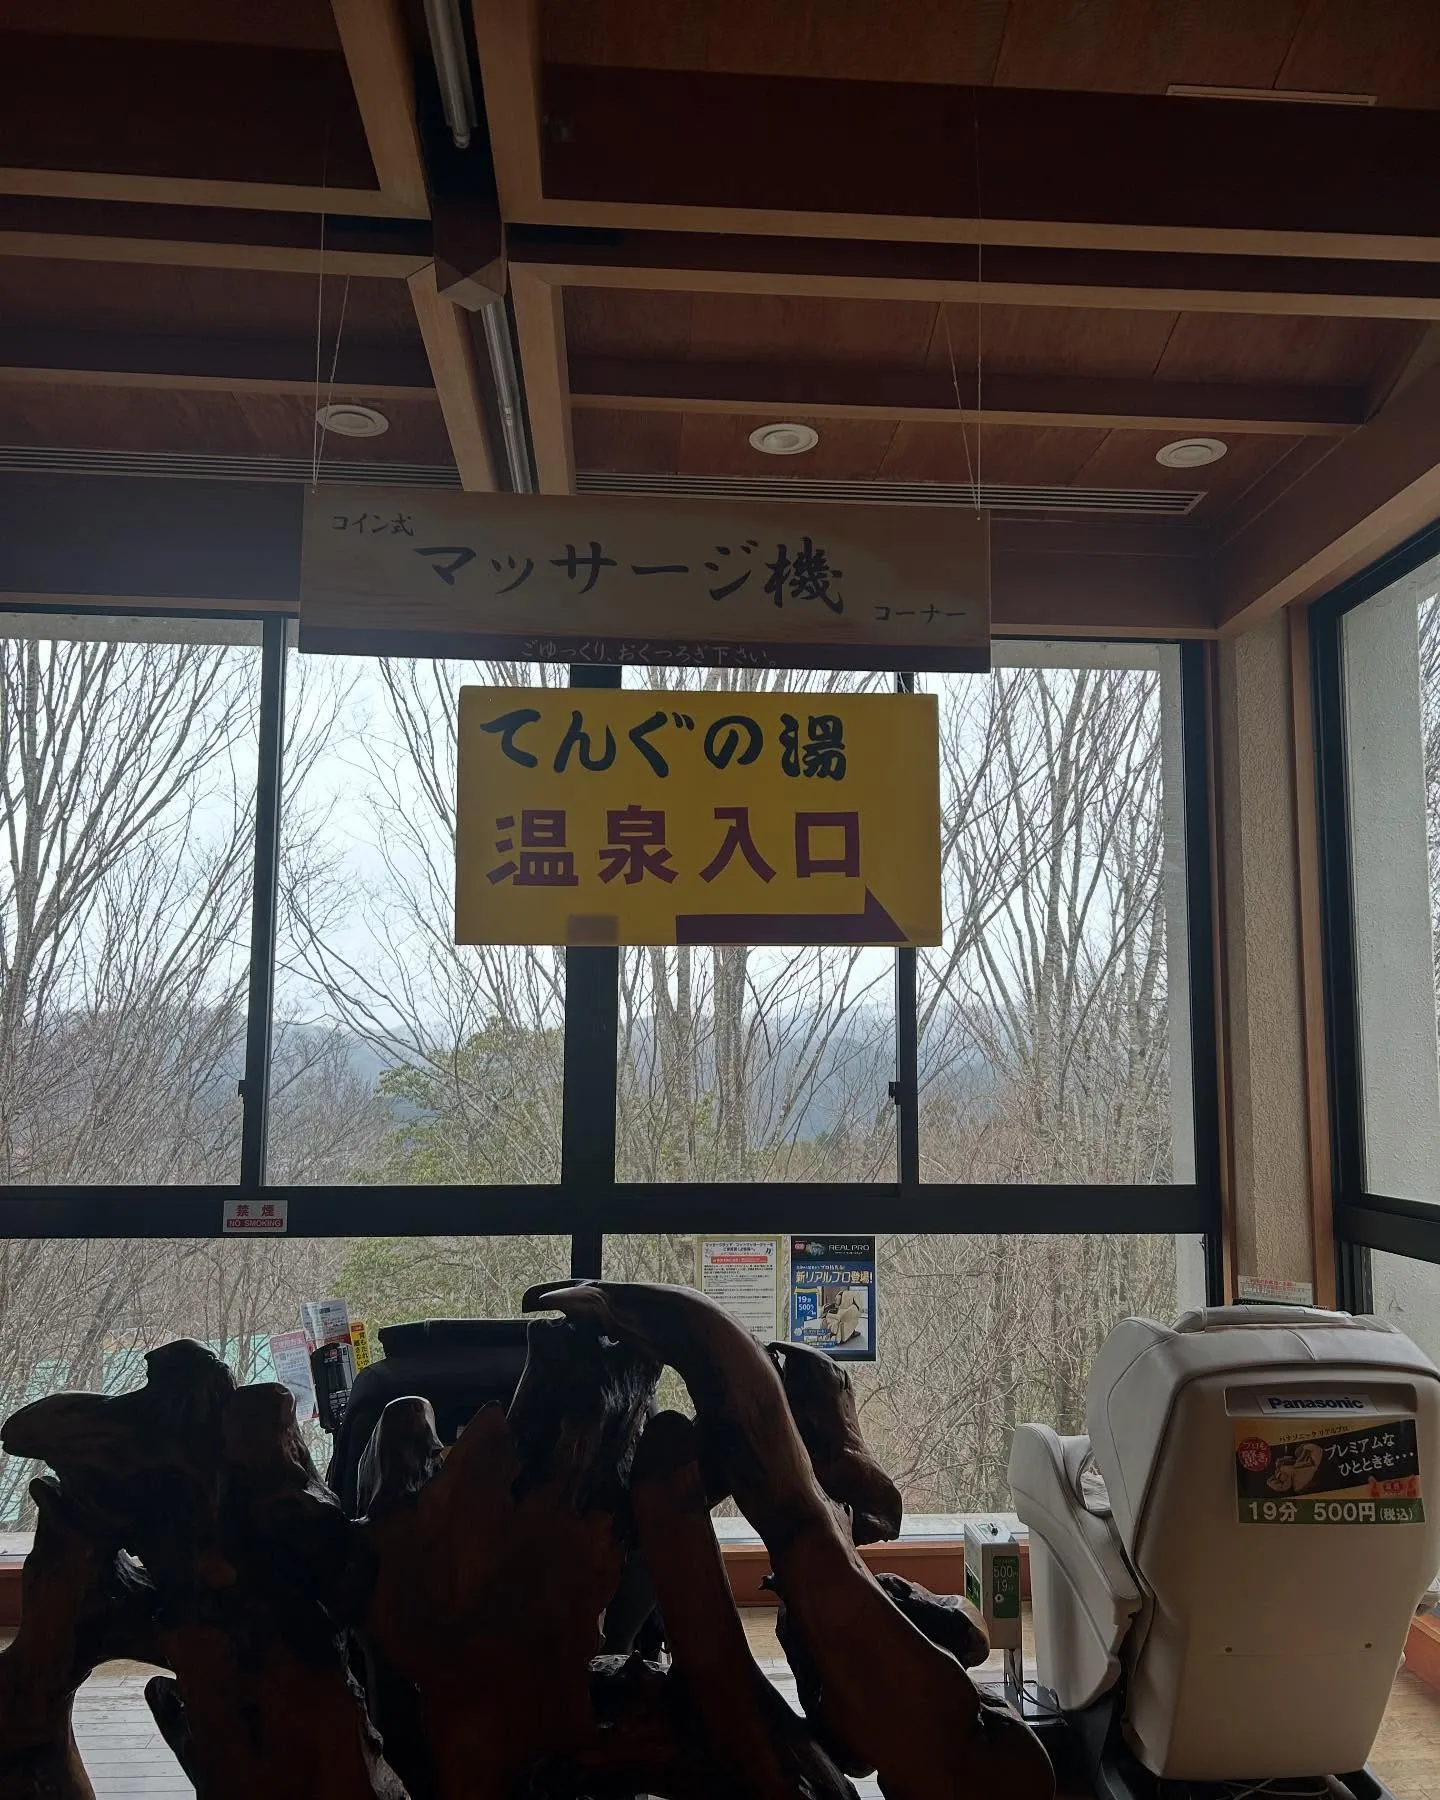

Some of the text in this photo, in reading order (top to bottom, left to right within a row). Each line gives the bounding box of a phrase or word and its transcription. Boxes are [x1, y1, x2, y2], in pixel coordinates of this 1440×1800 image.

[332, 513, 415, 537] コイン式
[413, 536, 844, 614] マッサージ機
[874, 602, 968, 624] コーナー
[480, 708, 848, 782] てんぐの湯
[485, 805, 860, 887] 温泉入口
[236, 1204, 275, 1217] 禁煙
[1268, 1397, 1365, 1410] Panasonic
[1324, 1432, 1396, 1461] プレミアムな
[1248, 1502, 1298, 1522] 19分
[1314, 1502, 1376, 1522] 500円
